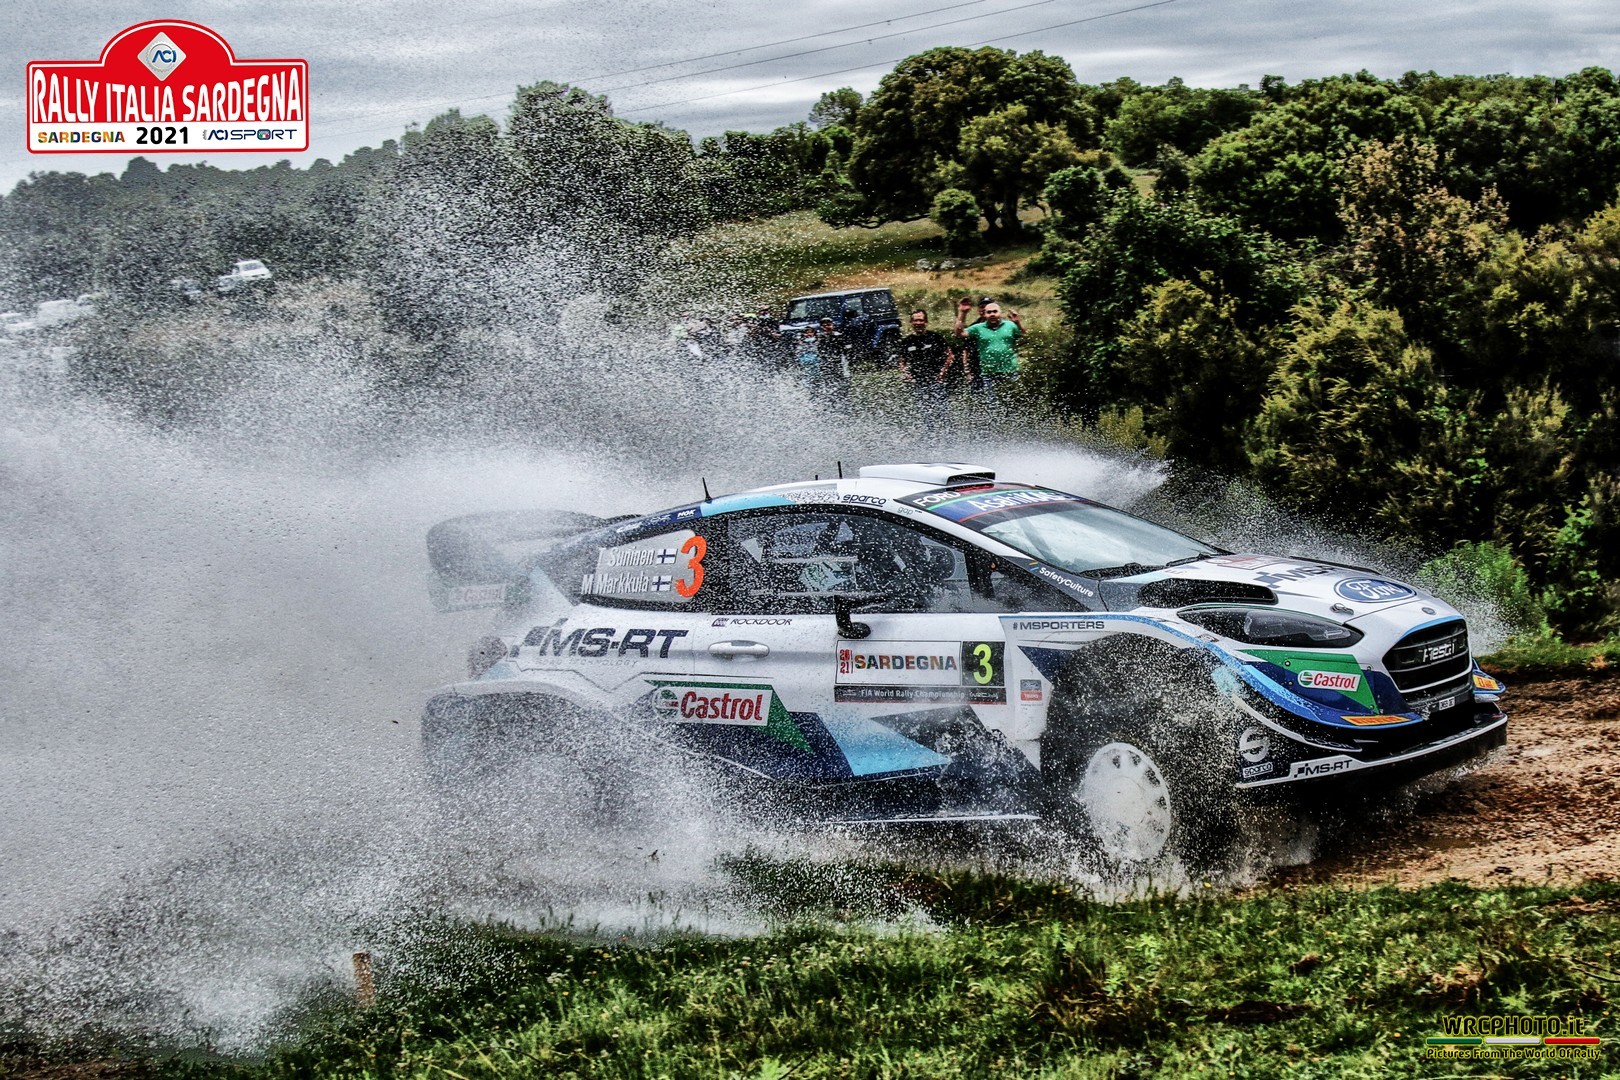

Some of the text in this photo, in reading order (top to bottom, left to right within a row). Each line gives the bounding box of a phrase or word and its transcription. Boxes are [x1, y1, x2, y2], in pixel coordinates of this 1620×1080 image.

[842, 493, 887, 507] sparco
[913, 491, 961, 507] FORD
[608, 546, 655, 567] Suninen
[675, 535, 707, 598] 3
[594, 571, 650, 594] Markkula
[1038, 566, 1095, 598] SafetyCulture
[1346, 579, 1404, 600] Ford
[730, 618, 793, 626] ROCKDOOR
[538, 627, 689, 659] MS-RT
[854, 654, 957, 671] SARDEGNA
[972, 643, 993, 684] 3
[1313, 672, 1356, 689] Castrol
[874, 689, 894, 698] World
[895, 689, 913, 699] Rally
[680, 691, 763, 721] Castrol
[1305, 759, 1353, 777] MS-RT
